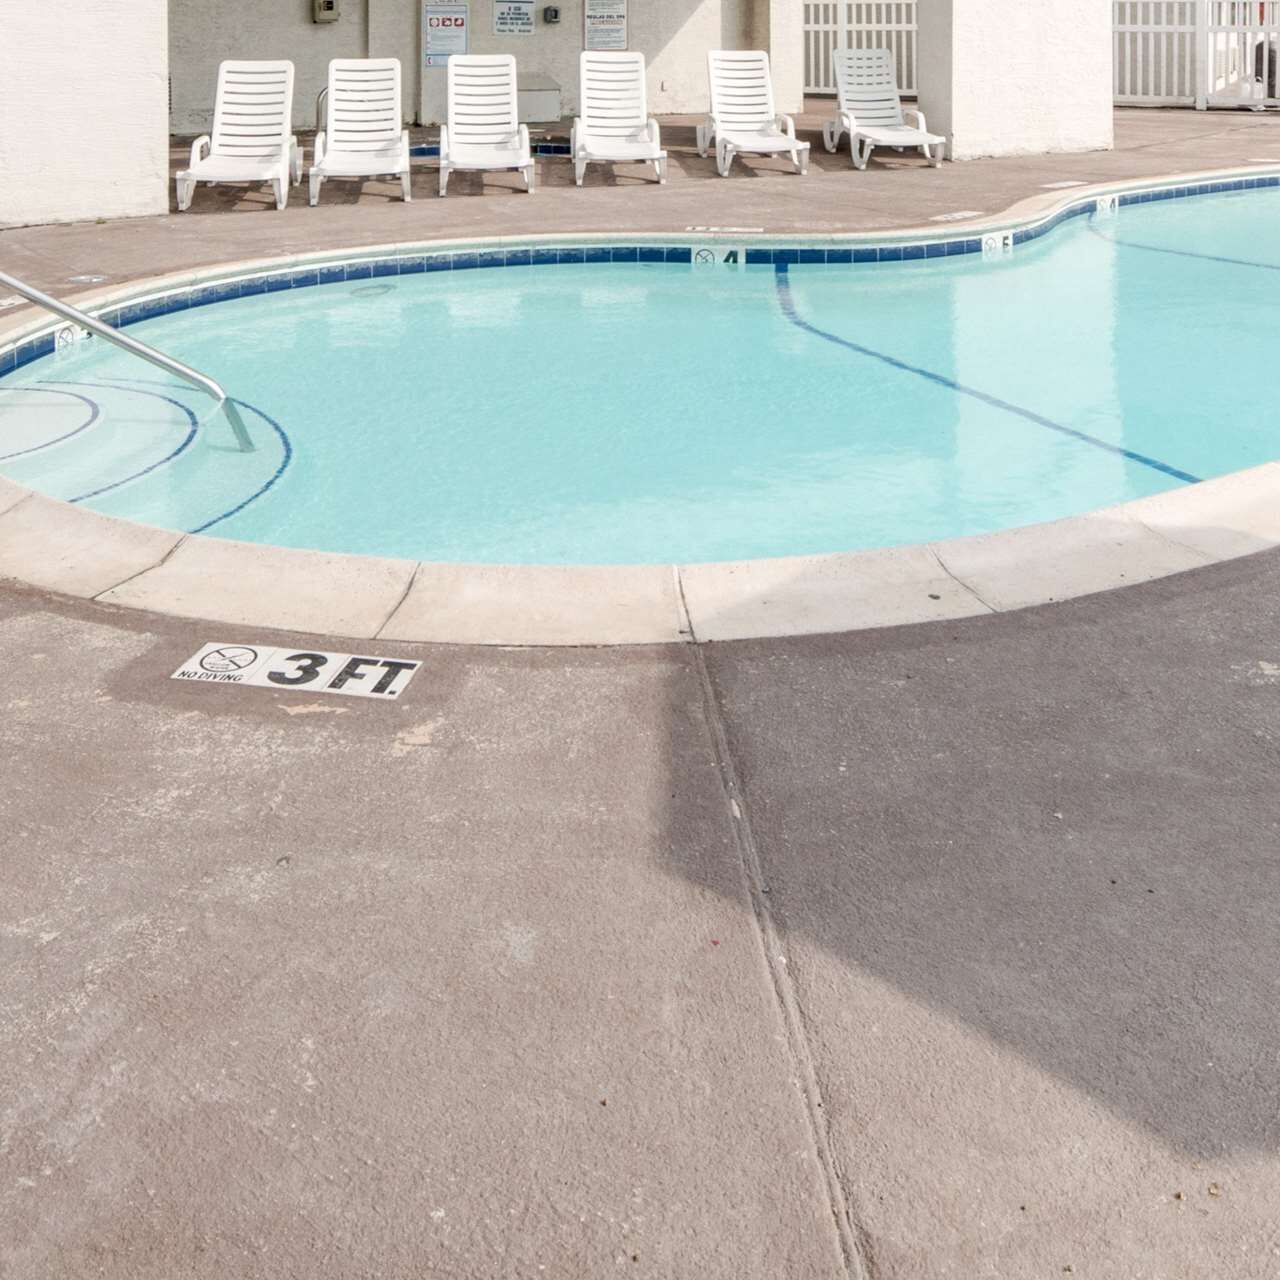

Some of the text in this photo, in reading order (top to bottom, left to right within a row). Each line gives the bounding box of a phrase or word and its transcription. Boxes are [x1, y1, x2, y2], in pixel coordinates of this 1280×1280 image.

[177, 670, 244, 682] NO DIVING
[267, 653, 417, 695] 3 FT.
